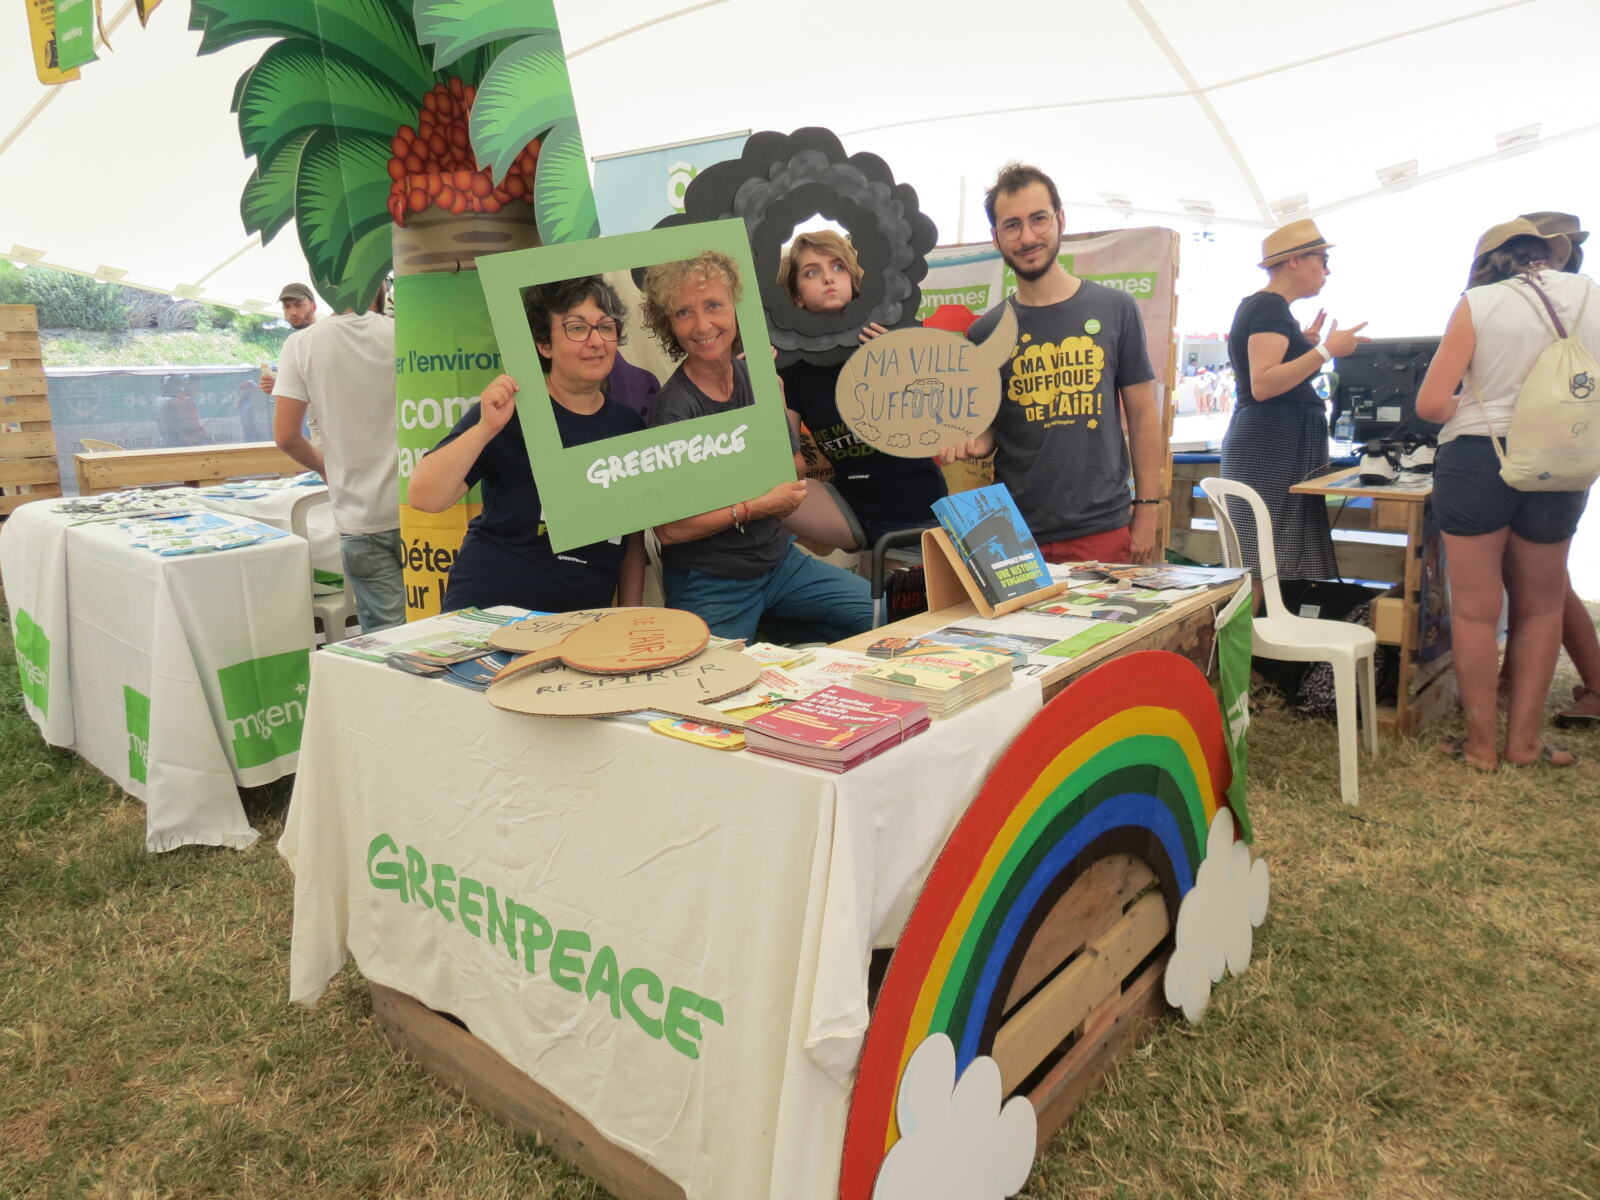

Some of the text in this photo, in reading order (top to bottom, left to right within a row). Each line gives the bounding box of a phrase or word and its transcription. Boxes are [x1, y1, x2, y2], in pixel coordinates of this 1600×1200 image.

[863, 344, 971, 377] MA VILLE
[1020, 356, 1046, 374] MA
[1013, 369, 1094, 395] SUFFOQUE
[851, 382, 980, 424] SUFFOQUE
[1025, 406, 1045, 422] DE
[586, 424, 749, 489] GREENPEACE
[536, 664, 725, 695] RESPIRER
[229, 699, 304, 741] mgen
[367, 833, 724, 1060] GREENPEACE
